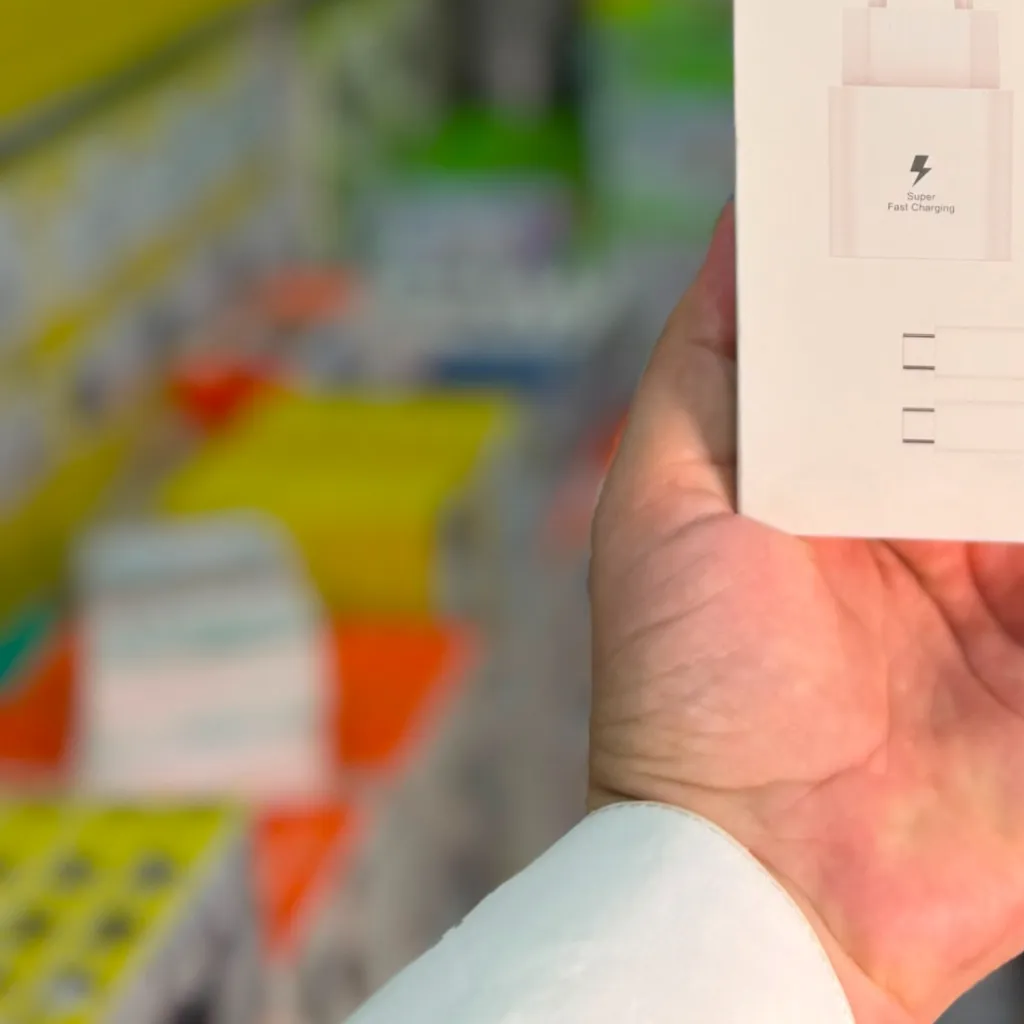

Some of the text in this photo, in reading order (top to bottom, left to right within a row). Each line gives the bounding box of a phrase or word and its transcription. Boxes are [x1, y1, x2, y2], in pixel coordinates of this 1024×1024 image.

[907, 191, 936, 203] Super
[887, 202, 956, 215] Fast Charging
